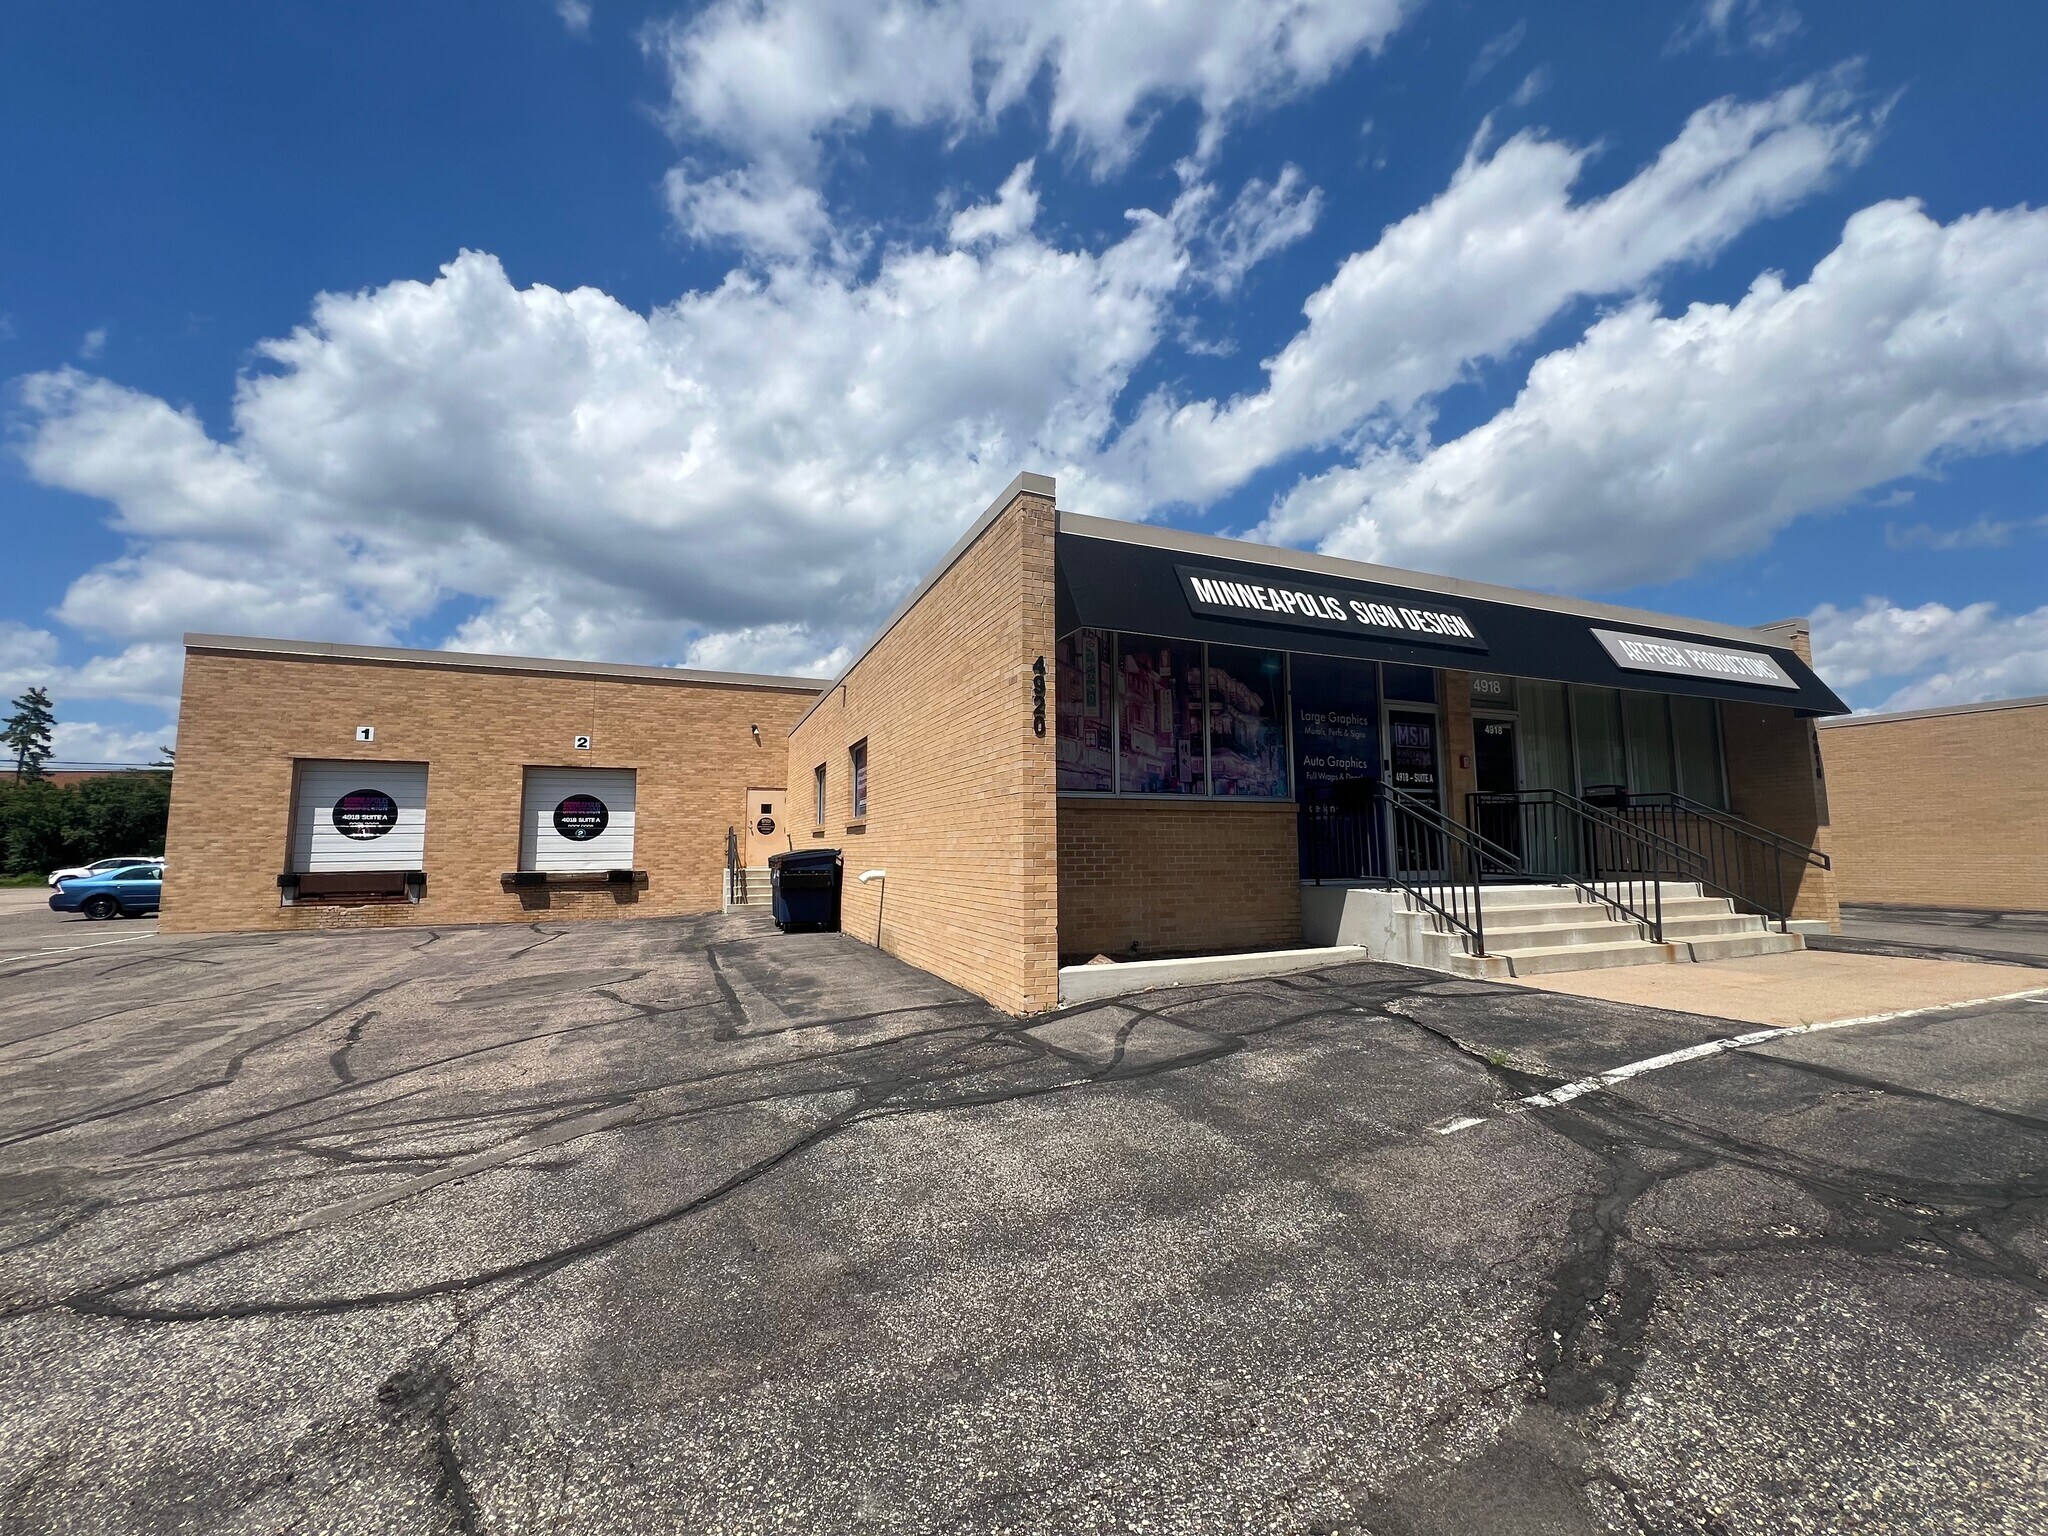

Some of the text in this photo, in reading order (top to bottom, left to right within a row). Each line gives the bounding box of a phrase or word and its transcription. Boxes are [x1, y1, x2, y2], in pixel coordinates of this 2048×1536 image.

[1190, 577, 1475, 638] MINNEAPOLIS SIGN DESIGN
[1618, 639, 1779, 680] ART-TECH PRODUCTIONS
[1473, 679, 1501, 694] 4918
[1033, 655, 1046, 738] 4920
[1301, 709, 1368, 726] Large Graphics
[361, 728, 370, 739] 1
[1350, 730, 1366, 740] Signs
[1484, 725, 1503, 735] 4918
[577, 737, 588, 748] 2
[1303, 755, 1367, 770] Auto Graphics
[1306, 772, 1317, 780] Full
[1318, 772, 1339, 782] Wraps
[1414, 773, 1429, 782] SUITE
[1429, 774, 1434, 783] A
